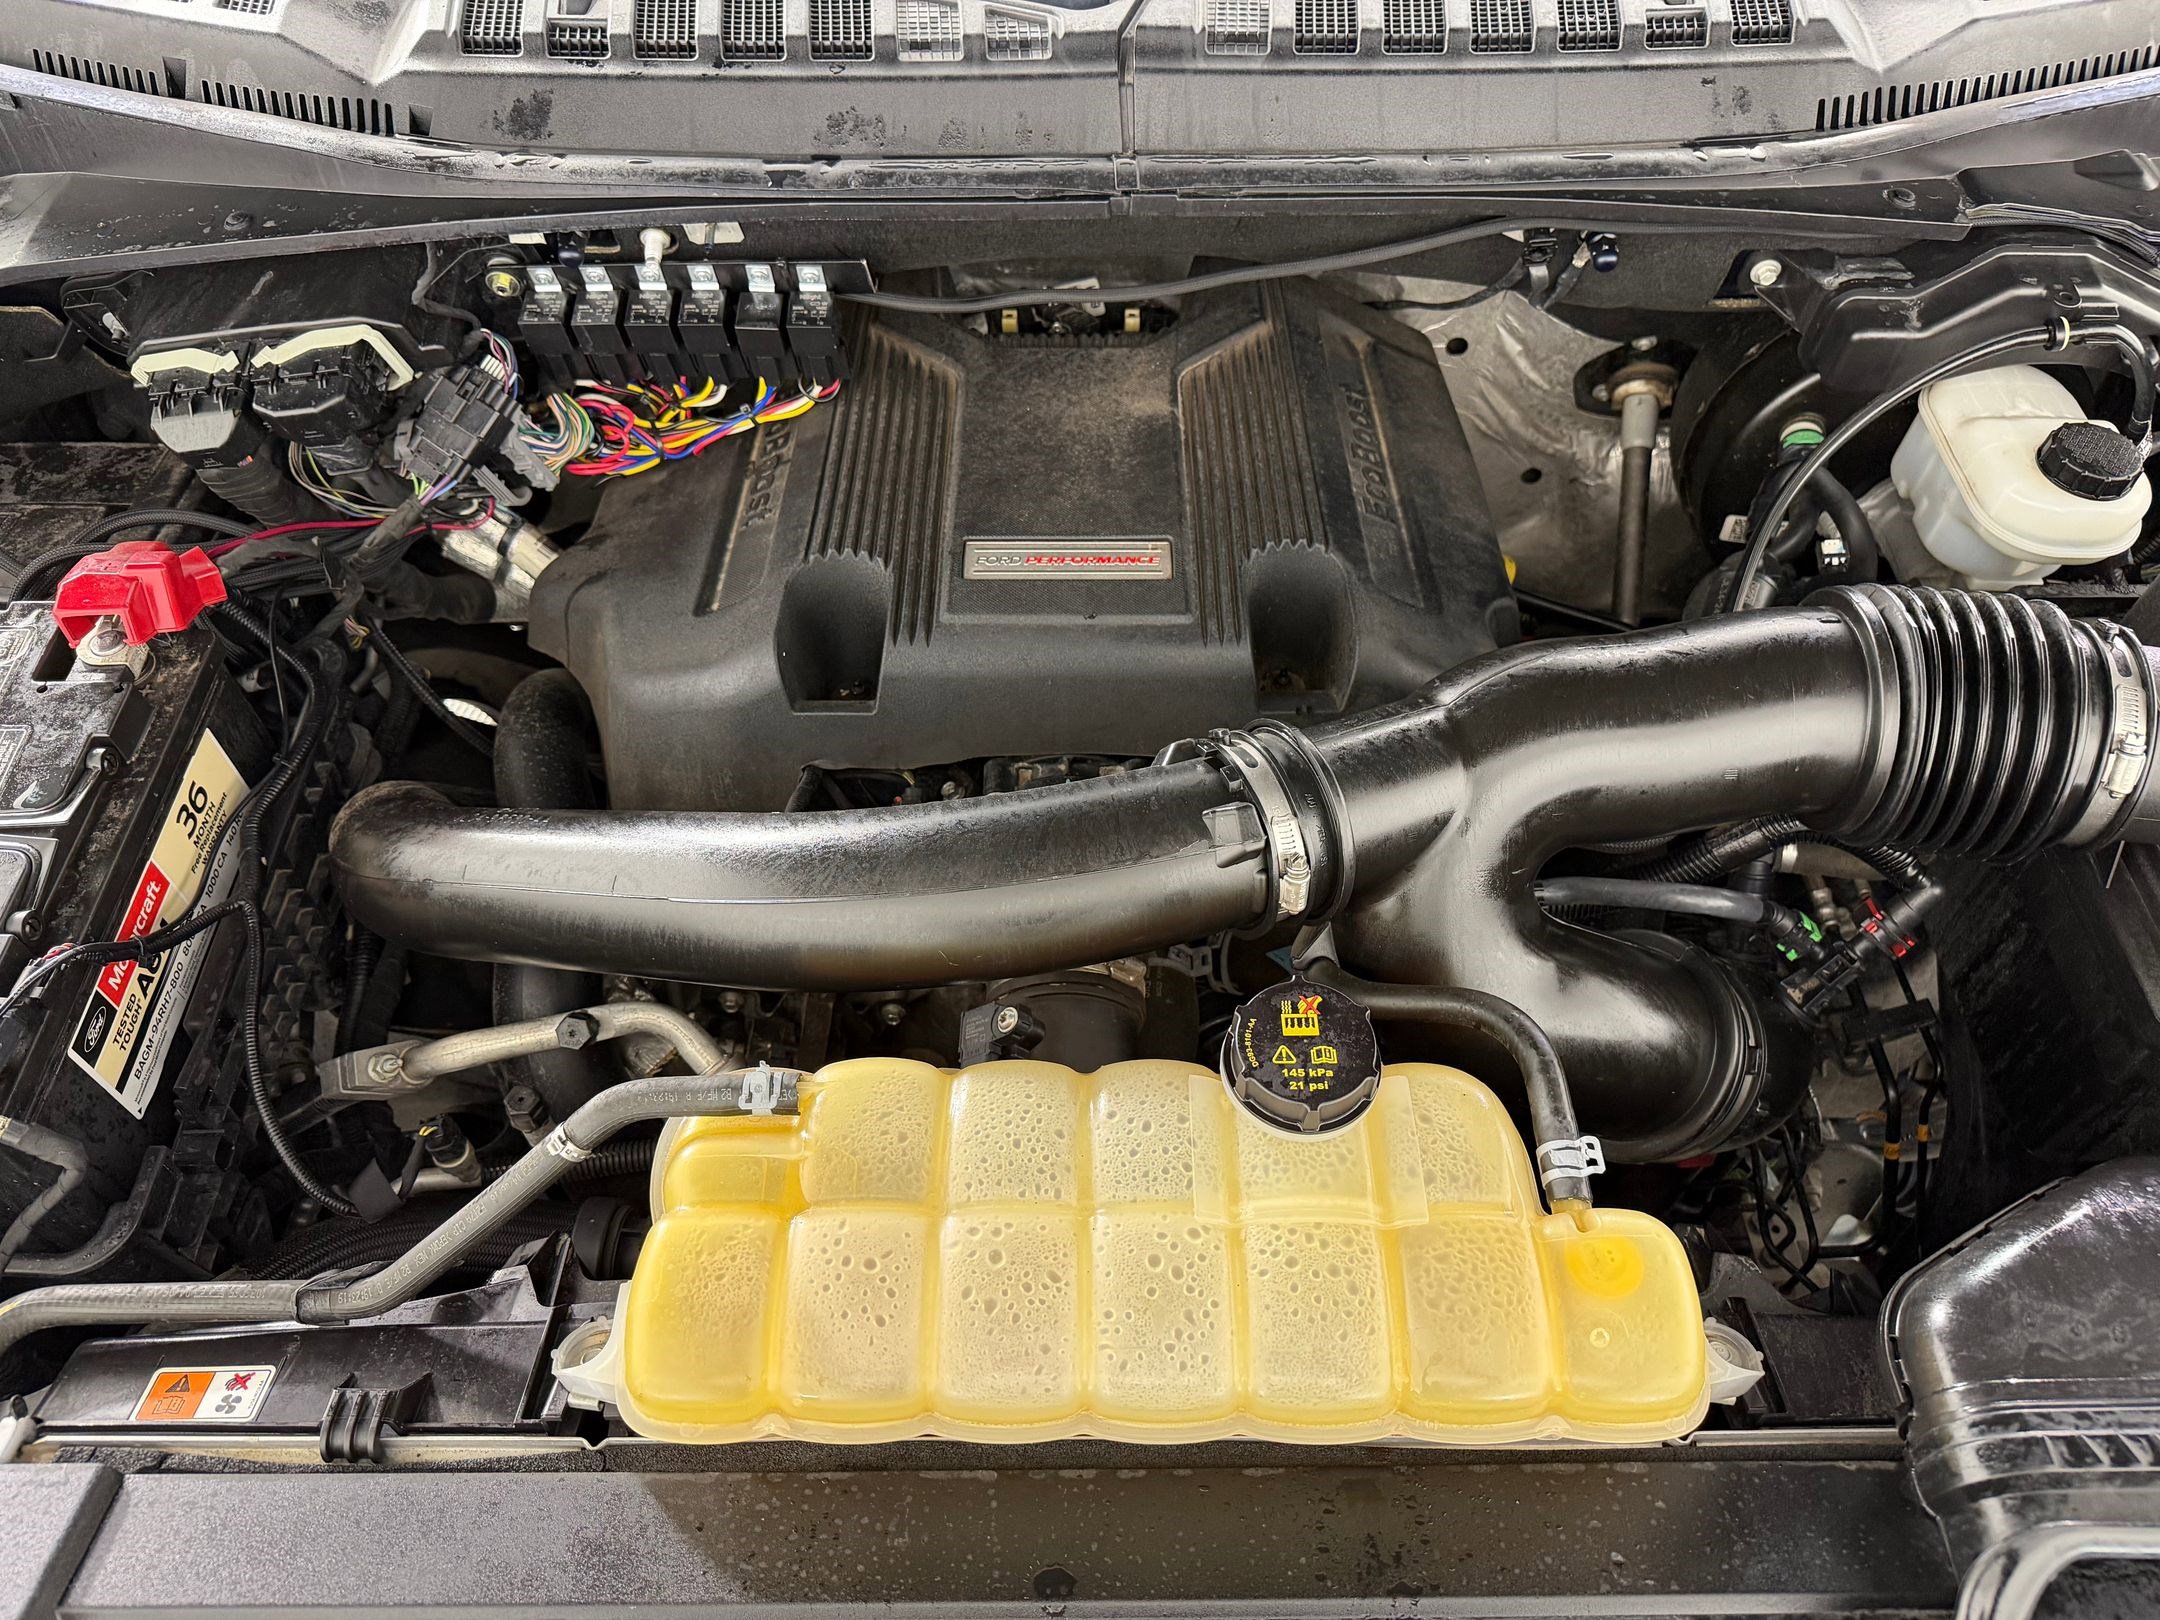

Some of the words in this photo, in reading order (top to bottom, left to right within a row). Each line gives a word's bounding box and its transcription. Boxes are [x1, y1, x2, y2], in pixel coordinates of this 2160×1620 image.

[975, 555, 1022, 566] FORD
[1024, 555, 1161, 566] PERFORMANCE
[175, 780, 208, 840] 36
[191, 851, 201, 874] Free
[199, 792, 228, 853] Replacement
[193, 801, 216, 848] MONTH
[107, 880, 161, 991] Morcraft
[134, 962, 184, 1080] BAGM-94RH7-800
[205, 869, 220, 899] 1000
[218, 852, 228, 869] CA
[226, 826, 237, 847] 140
[87, 1013, 104, 1045] Ford
[112, 993, 137, 1045] TESTED
[1244, 1018, 1259, 1068] DG93-8101-AA
[1282, 1068, 1305, 1077] 145
[1309, 1068, 1334, 1077] kPa
[1289, 1081, 1304, 1090] 21
[1309, 1081, 1329, 1091] psi
